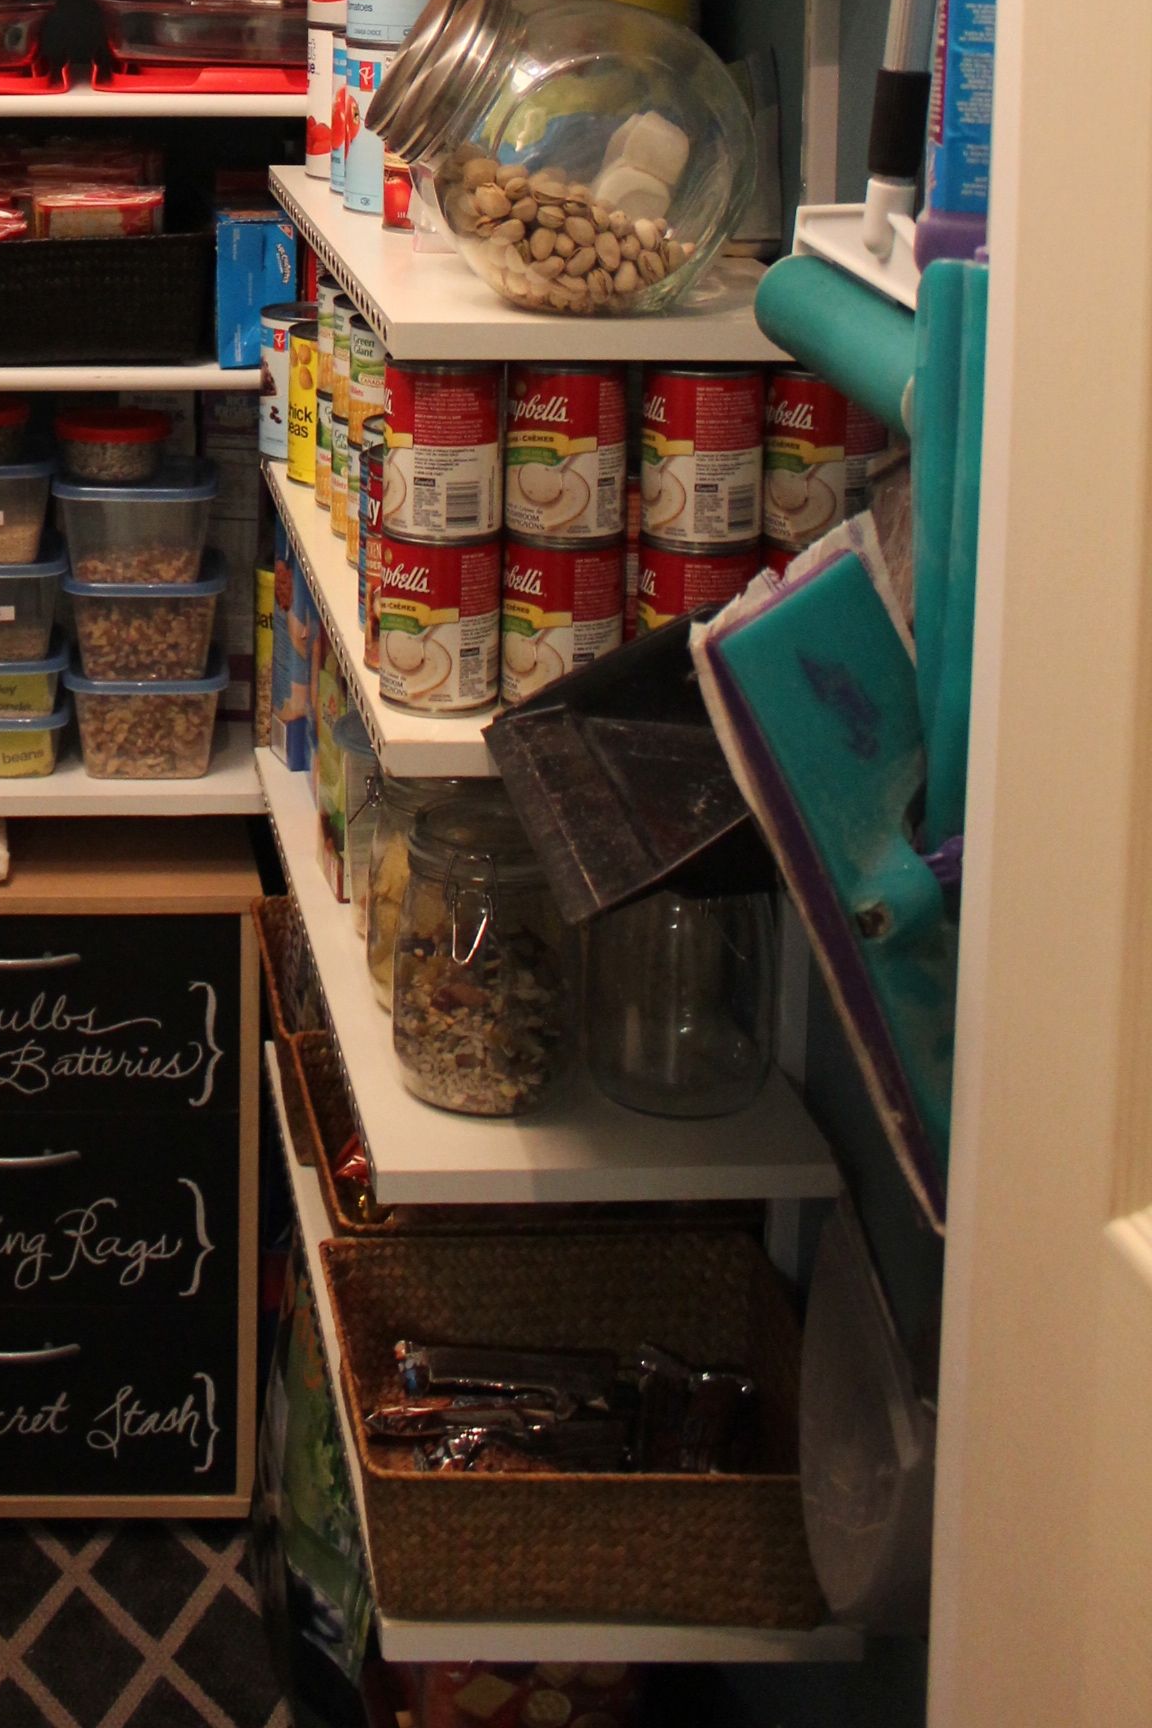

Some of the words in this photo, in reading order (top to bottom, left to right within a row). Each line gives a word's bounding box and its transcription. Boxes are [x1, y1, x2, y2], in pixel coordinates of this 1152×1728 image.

[348, 2, 374, 13] matoes
[352, 334, 375, 348] Green
[352, 345, 374, 358] Giant
[289, 403, 313, 423] hick
[507, 393, 569, 422] mpbell's
[766, 400, 814, 430] pbell's
[289, 421, 309, 438] eas
[334, 429, 348, 440] Gre
[334, 439, 348, 449] Gia
[381, 562, 430, 593] mpbell's
[503, 564, 544, 595] pbell's
[1, 748, 45, 765] beans
[50, 1198, 183, 1286] Rags
[86, 1385, 201, 1459] Stash
